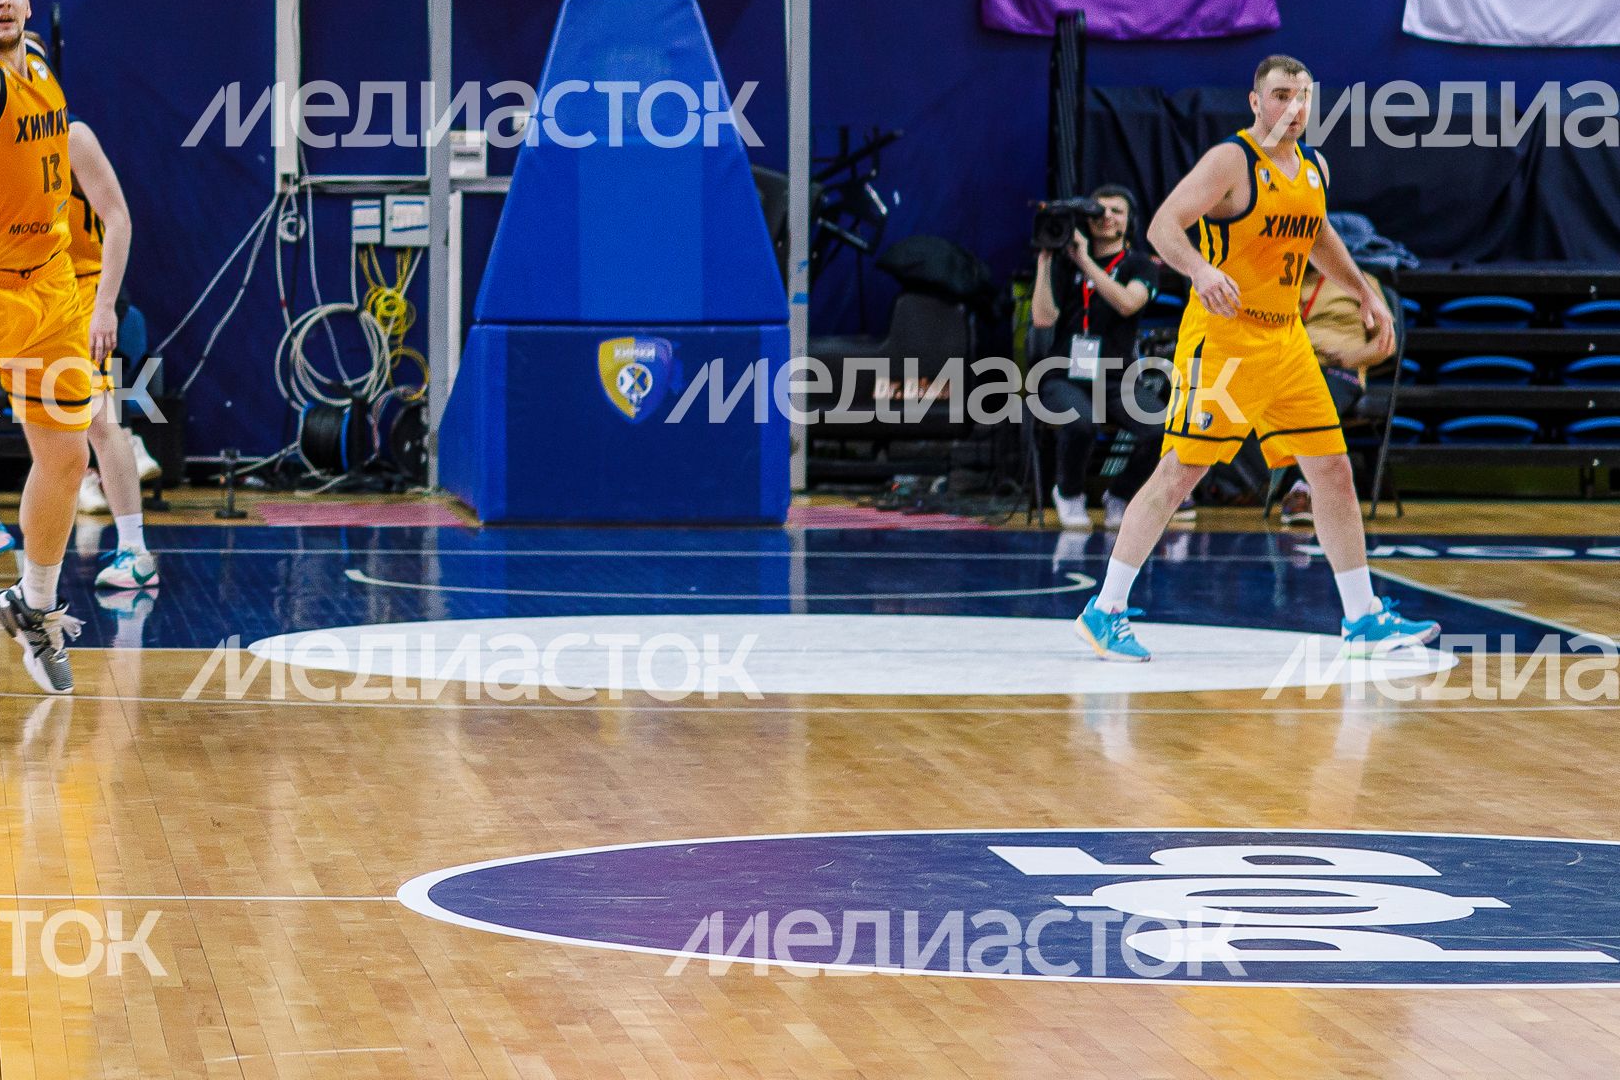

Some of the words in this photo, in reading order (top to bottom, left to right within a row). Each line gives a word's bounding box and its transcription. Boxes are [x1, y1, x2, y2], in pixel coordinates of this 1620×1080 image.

[41, 153, 63, 194] 13
[1279, 252, 1304, 286] 31
[987, 845, 1617, 963] РФБ
